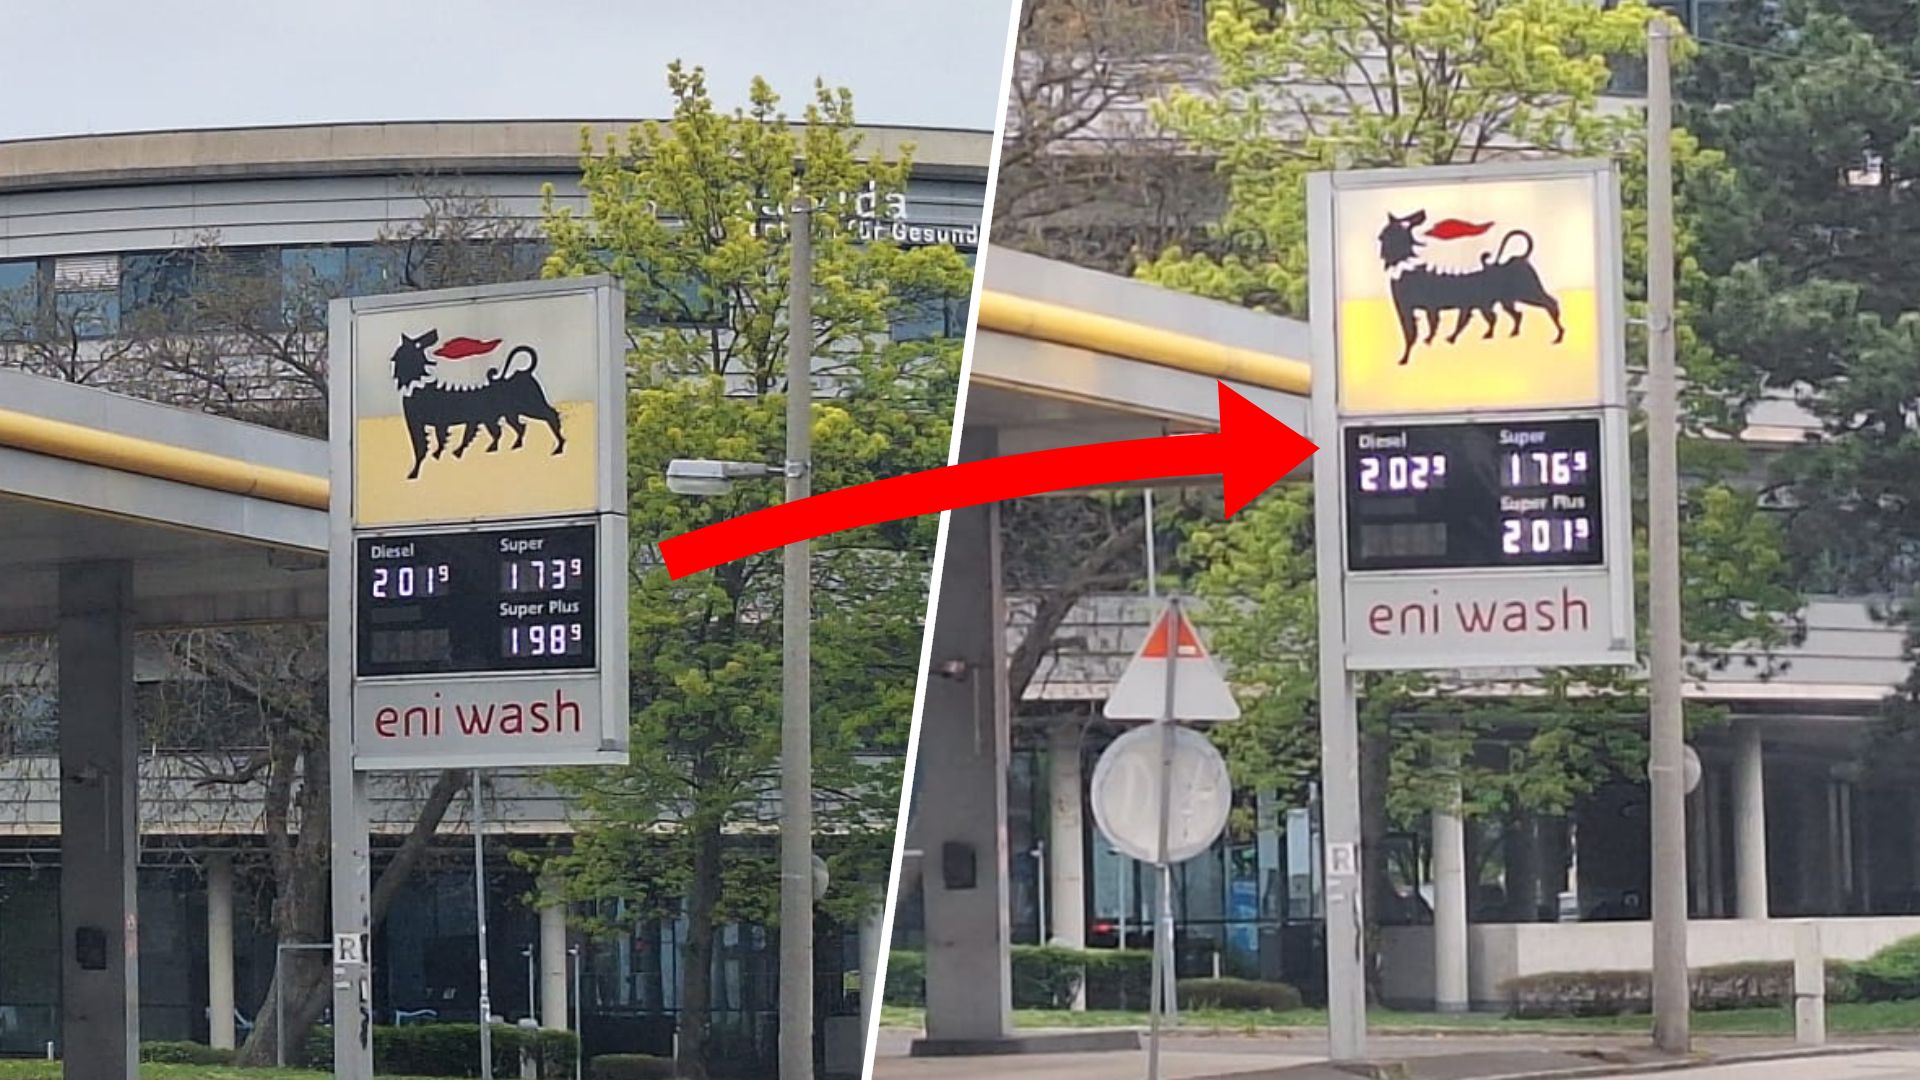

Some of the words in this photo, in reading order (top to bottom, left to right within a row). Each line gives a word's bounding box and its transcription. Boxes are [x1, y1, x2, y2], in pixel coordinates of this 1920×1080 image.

[1358, 432, 1407, 449] Diesel
[1500, 430, 1546, 447] Super
[1500, 496, 1548, 513] Super
[1552, 495, 1586, 510] Plus
[371, 543, 415, 559] Diesel
[500, 538, 544, 554] Super
[500, 603, 544, 619] Super
[548, 600, 580, 614] Plus
[1369, 589, 1440, 635] eni
[1456, 587, 1588, 633] wash
[375, 692, 441, 738] eni
[455, 688, 580, 735] wash
[1332, 847, 1350, 872] R
[339, 937, 356, 960] R
